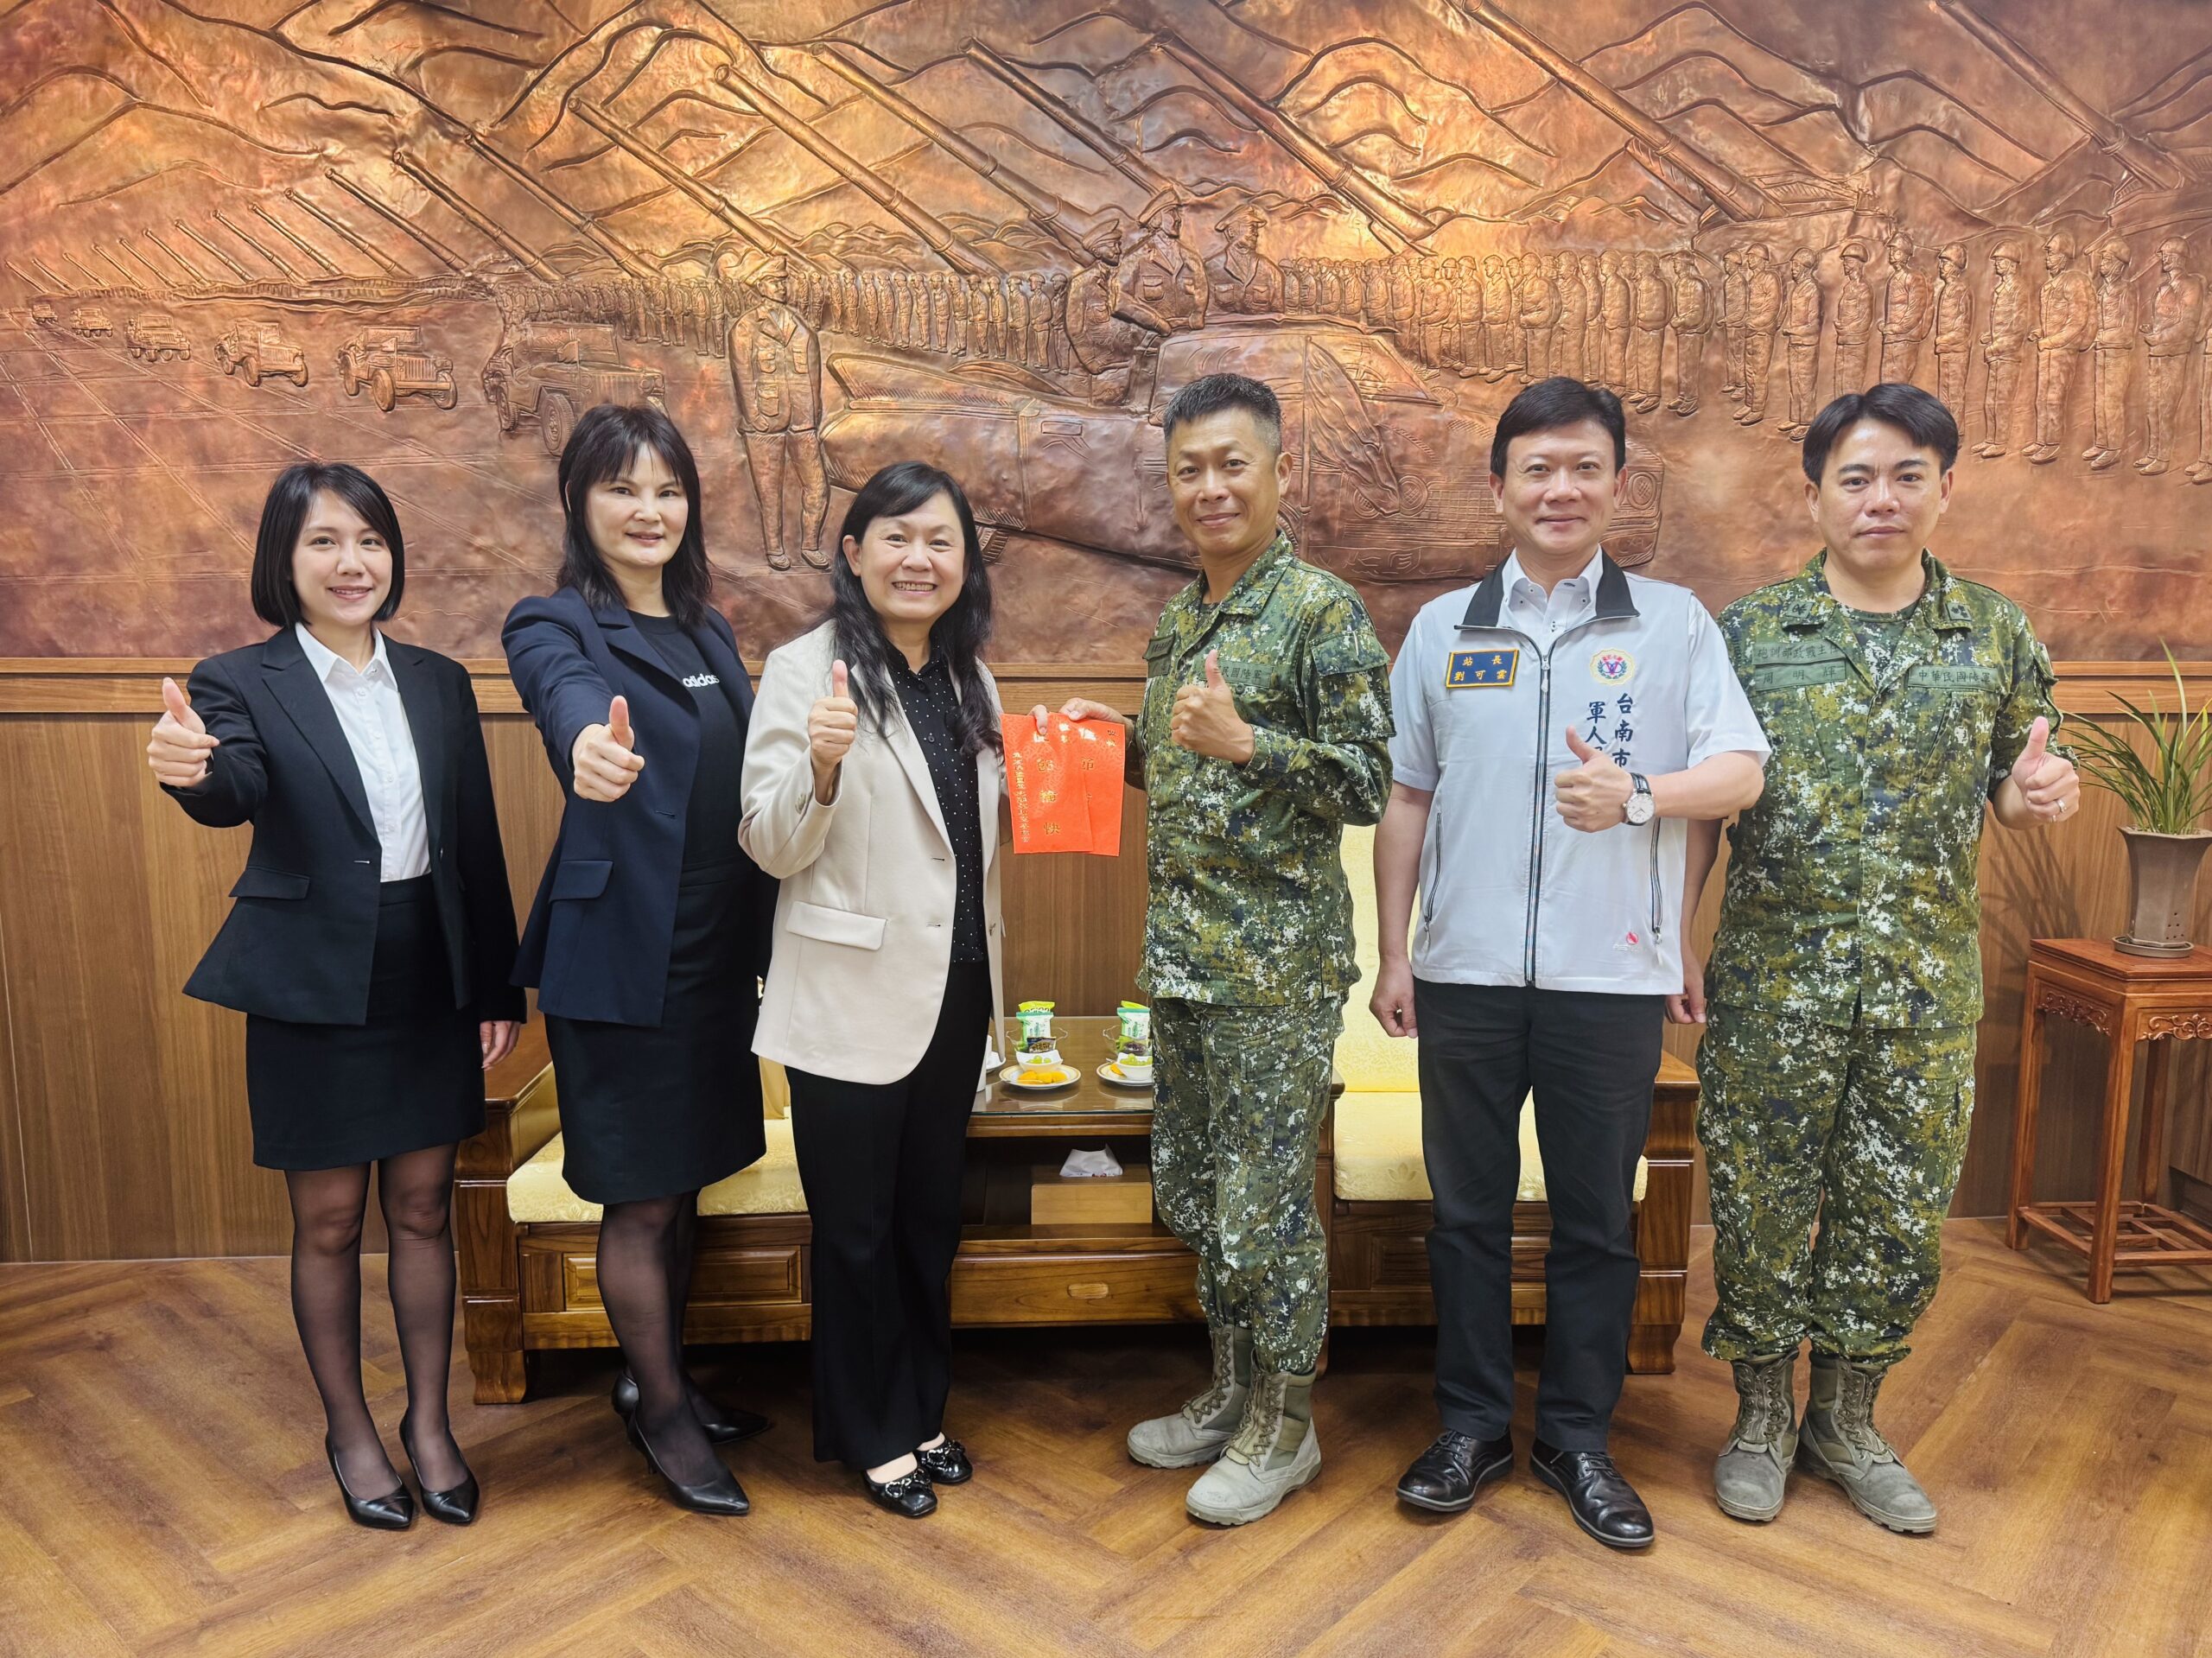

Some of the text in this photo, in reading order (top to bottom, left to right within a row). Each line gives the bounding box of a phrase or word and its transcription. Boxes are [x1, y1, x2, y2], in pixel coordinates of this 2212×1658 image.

[1462, 655, 1503, 666] 站長
[683, 673, 720, 688] adidas
[1918, 670, 1991, 683] 中華民國陸軍
[1585, 701, 1607, 751] 軍人
[1611, 692, 1633, 767] 台南市
